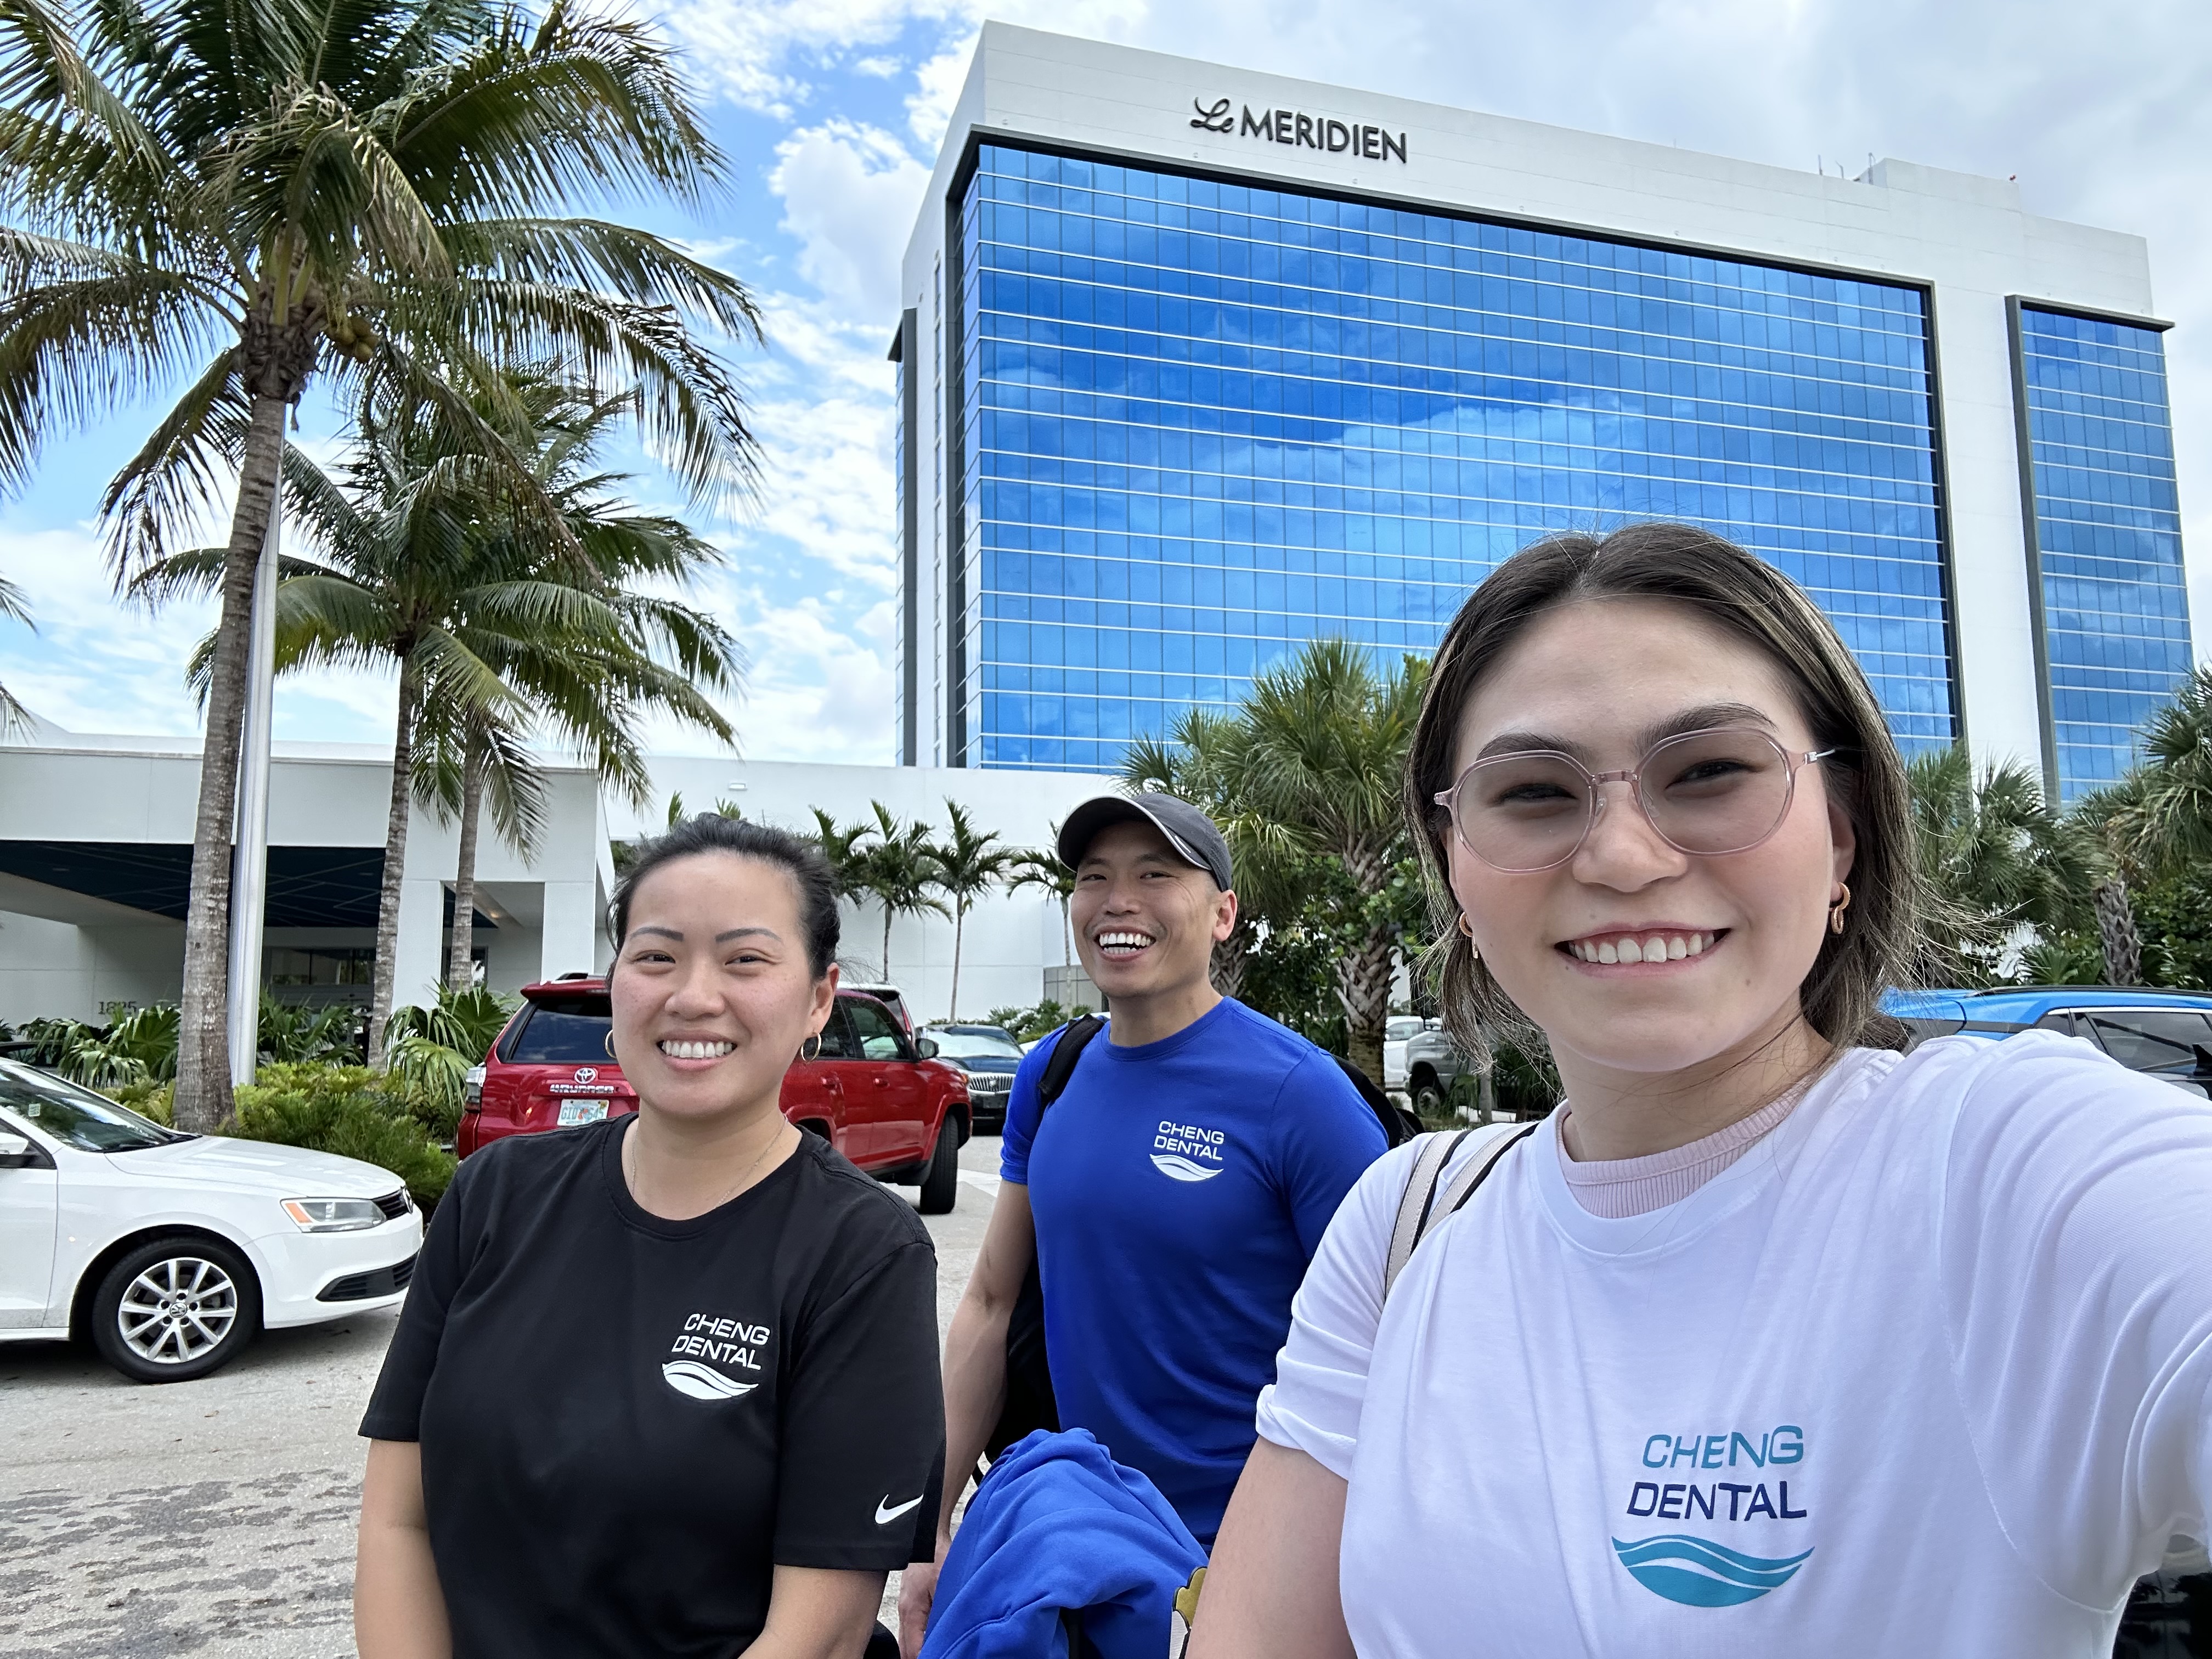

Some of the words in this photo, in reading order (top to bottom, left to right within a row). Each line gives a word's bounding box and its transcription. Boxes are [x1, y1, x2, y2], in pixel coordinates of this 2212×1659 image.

[1190, 97, 1233, 133] Le
[1154, 1135, 1223, 1160] DENTAL
[1159, 1121, 1224, 1144] CHENG
[684, 1314, 770, 1345] CHENG
[672, 1335, 761, 1370] DENTAL
[1643, 1425, 1804, 1469] CHENG
[1627, 1481, 1807, 1521] DENTAL
